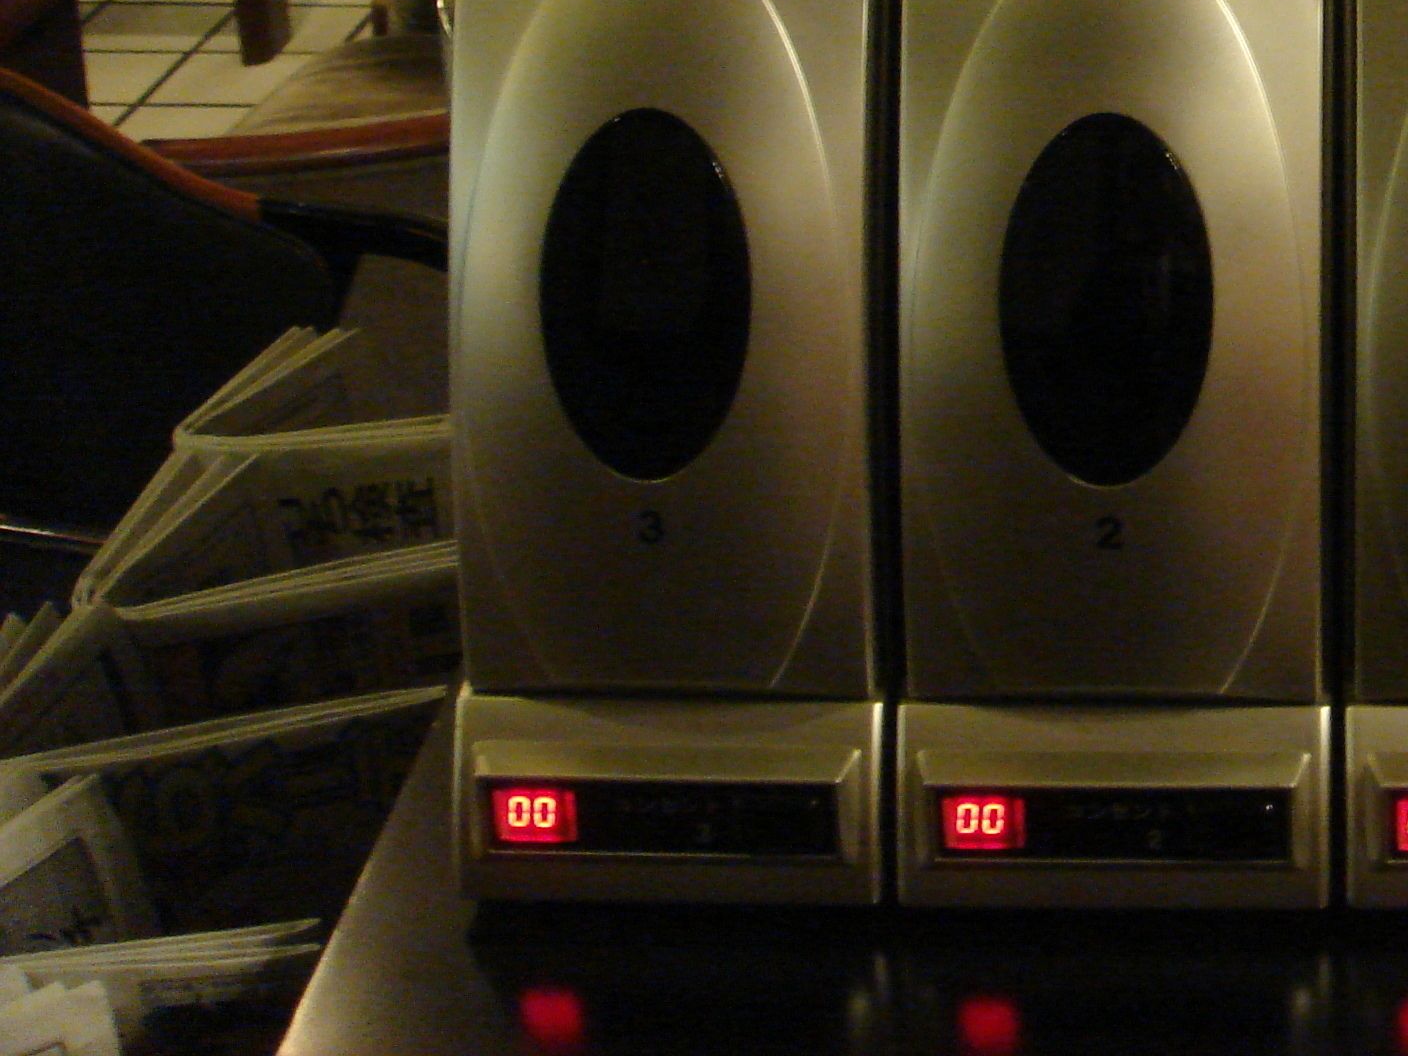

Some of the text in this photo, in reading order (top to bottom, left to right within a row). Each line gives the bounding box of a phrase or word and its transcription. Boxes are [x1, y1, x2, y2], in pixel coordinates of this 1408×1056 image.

[638, 510, 664, 543] 3
[1095, 517, 1123, 550] 2
[507, 796, 557, 829] 00
[955, 802, 1005, 834] 00
